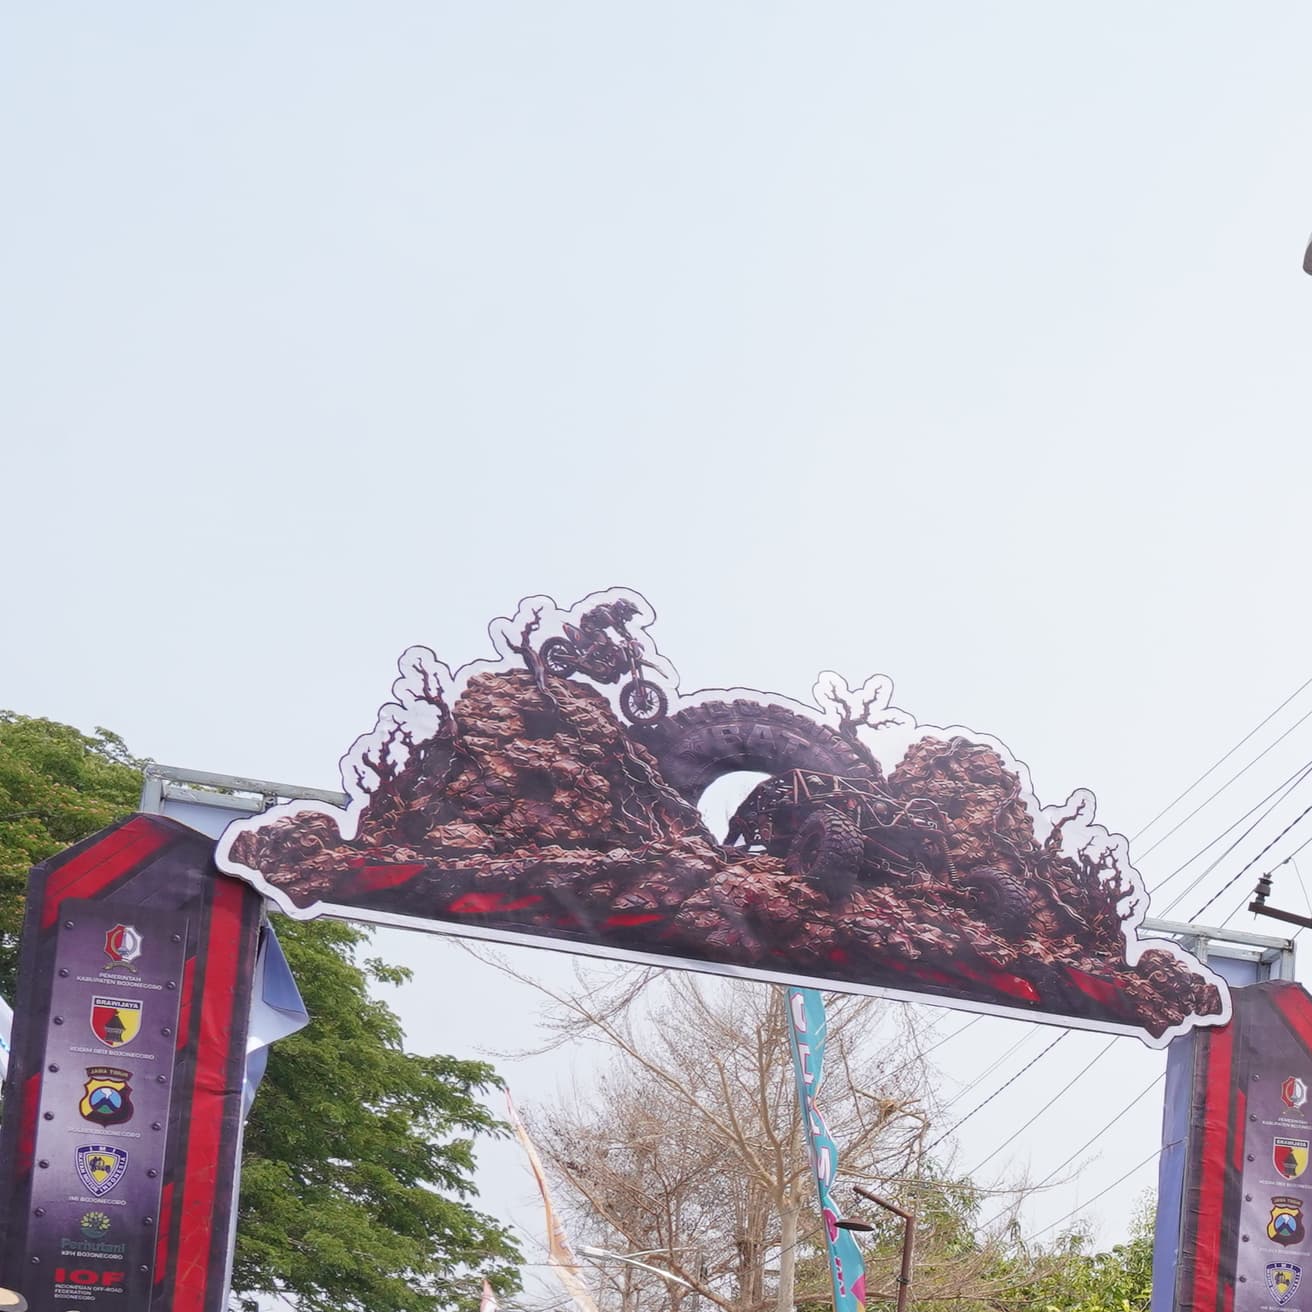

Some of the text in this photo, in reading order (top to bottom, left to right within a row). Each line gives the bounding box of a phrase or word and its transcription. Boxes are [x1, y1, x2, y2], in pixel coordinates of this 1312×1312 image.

[117, 980, 163, 991] BOJONEGORO
[95, 999, 139, 1009] BRAWIJAYA
[109, 1050, 154, 1060] BOJONEGORO
[100, 1156, 127, 1193] INDONESIA
[80, 1197, 127, 1206] BOJONEGORO
[61, 1238, 125, 1253] Perhutani
[77, 1251, 124, 1260] BOJONEGORO
[54, 1268, 125, 1286] IOF
